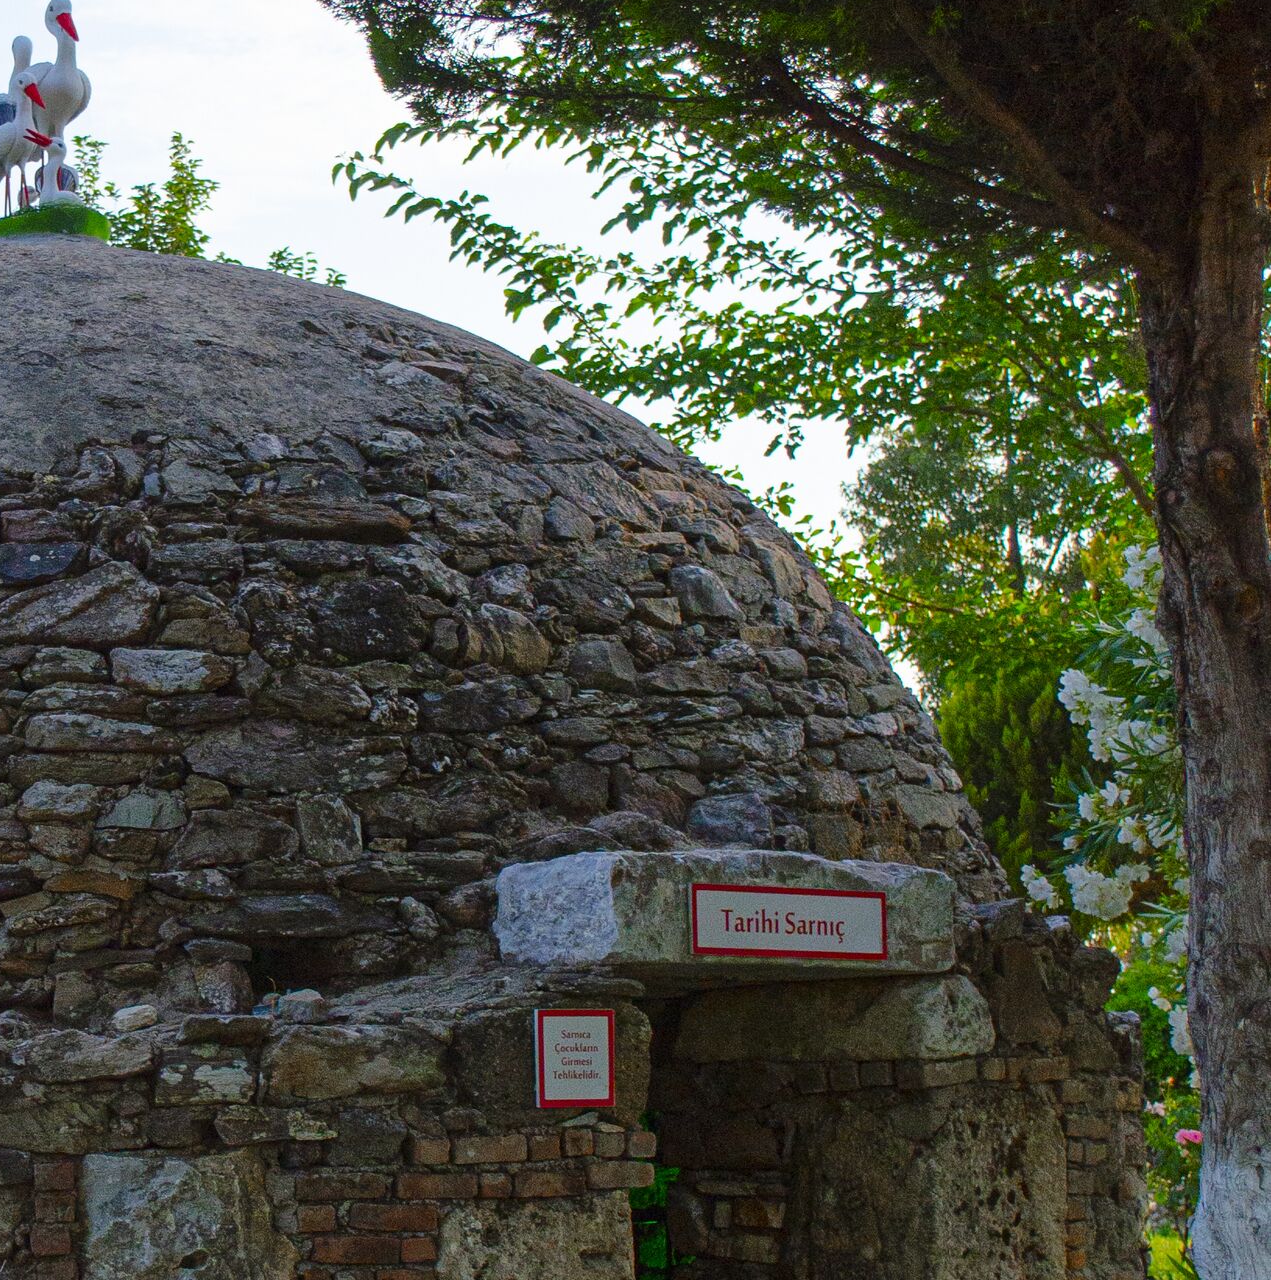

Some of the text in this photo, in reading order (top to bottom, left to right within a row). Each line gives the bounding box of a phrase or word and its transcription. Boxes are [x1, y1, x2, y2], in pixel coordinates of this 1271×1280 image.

[721, 909, 845, 943] Tarihi Sarnıç
[554, 1042, 599, 1055] Çocukların
[561, 1056, 593, 1066] Girmesi
[552, 1070, 601, 1080] Tehlikelidir.
